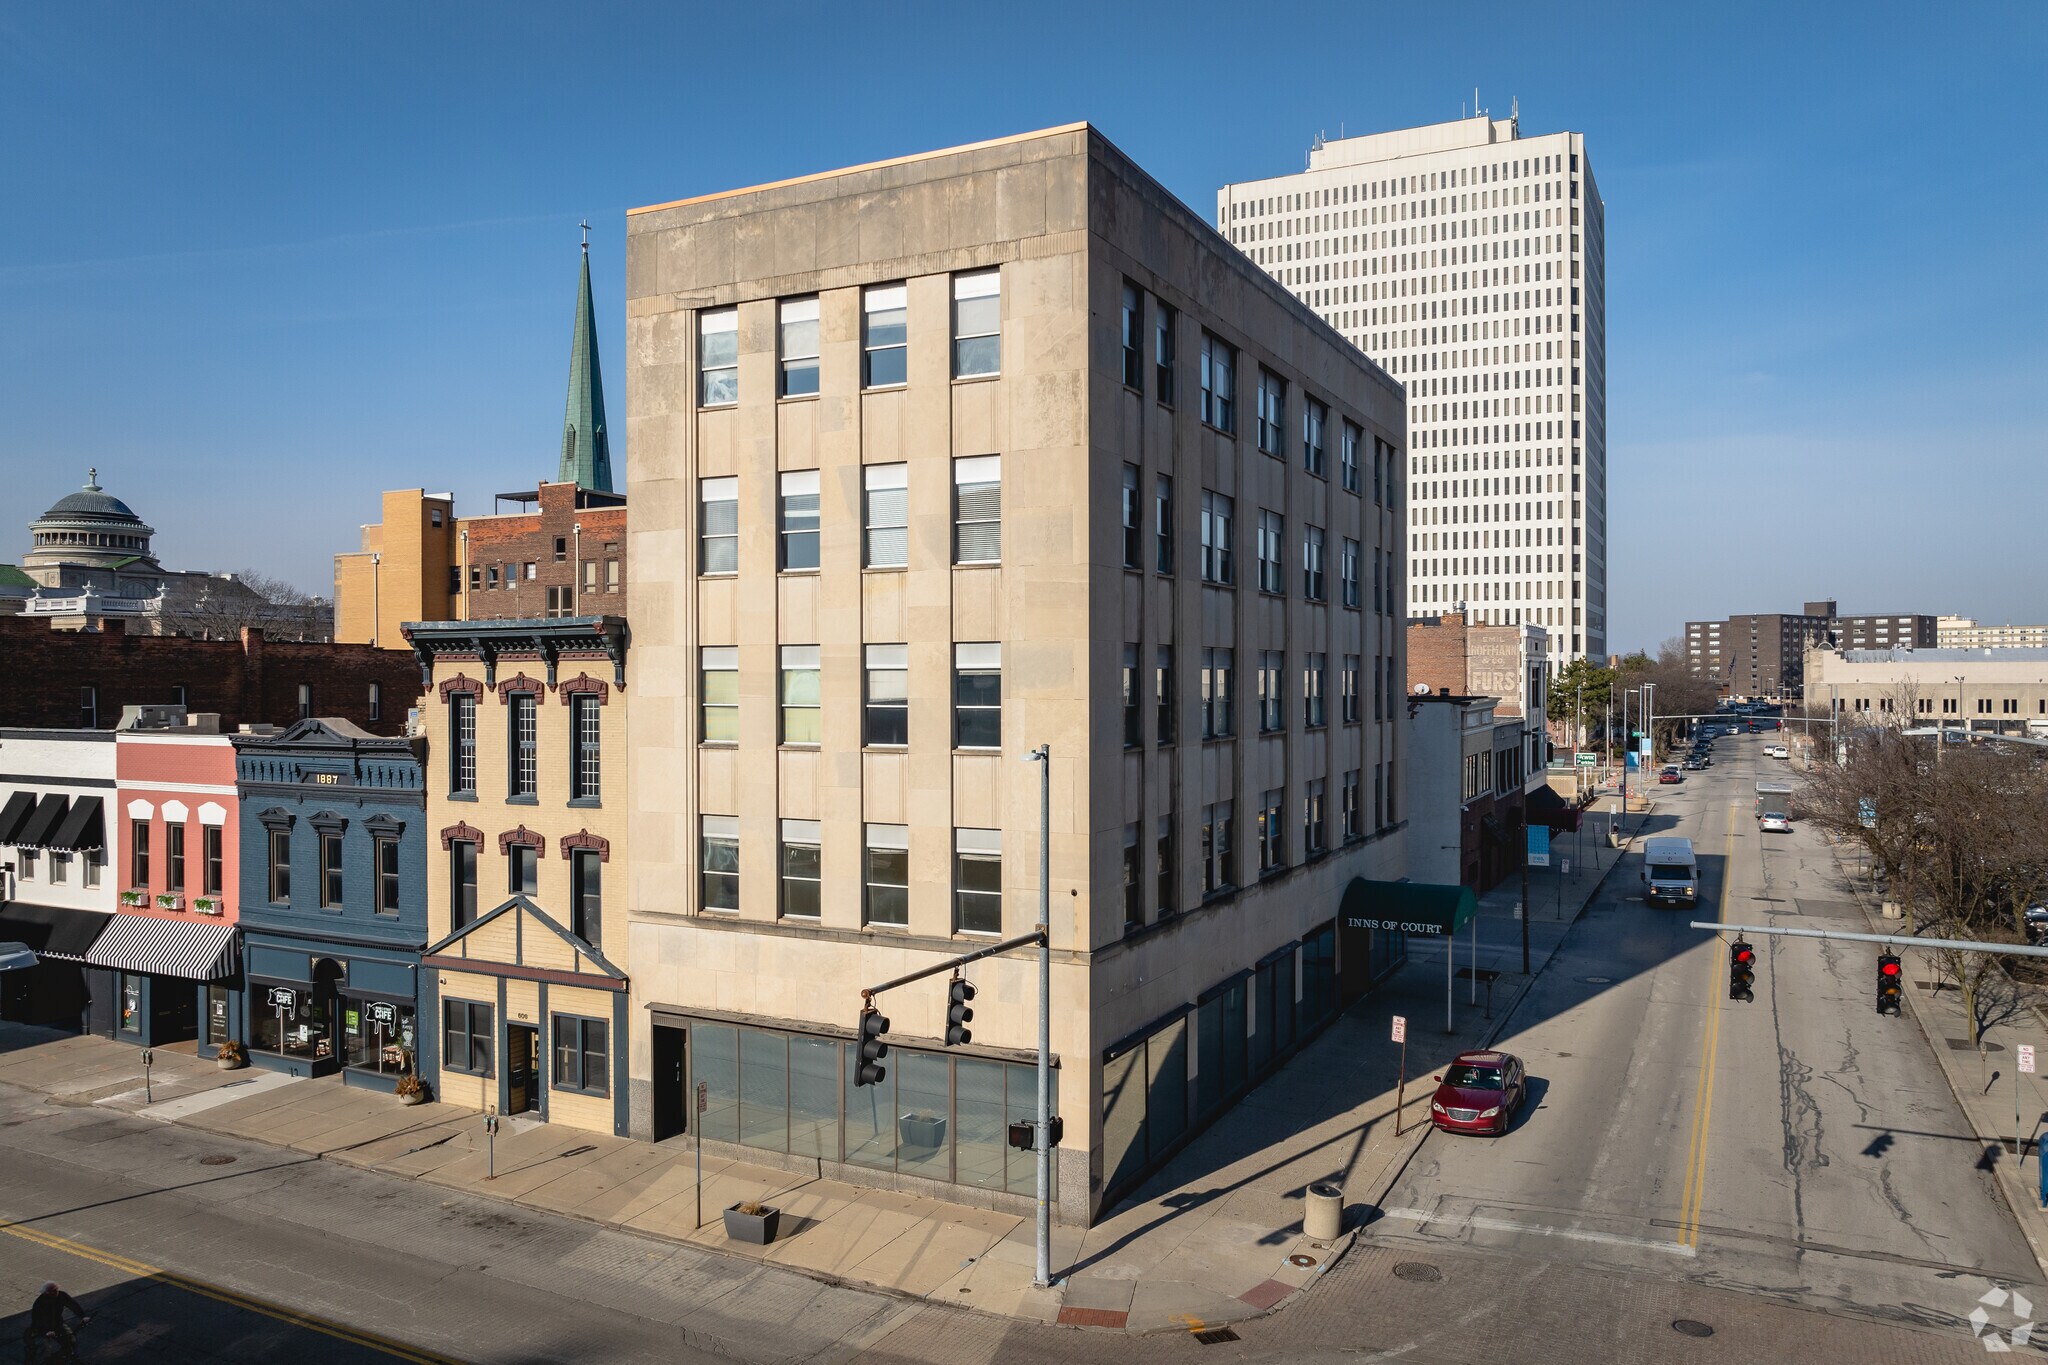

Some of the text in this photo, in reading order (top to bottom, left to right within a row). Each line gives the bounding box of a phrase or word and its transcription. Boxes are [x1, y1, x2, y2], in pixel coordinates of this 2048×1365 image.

[1472, 671, 1516, 691] FURS
[316, 774, 339, 784] 1887
[1348, 917, 1443, 934] INNS OF COURT
[276, 994, 292, 1005] CAFE
[374, 1009, 392, 1021] CAFE
